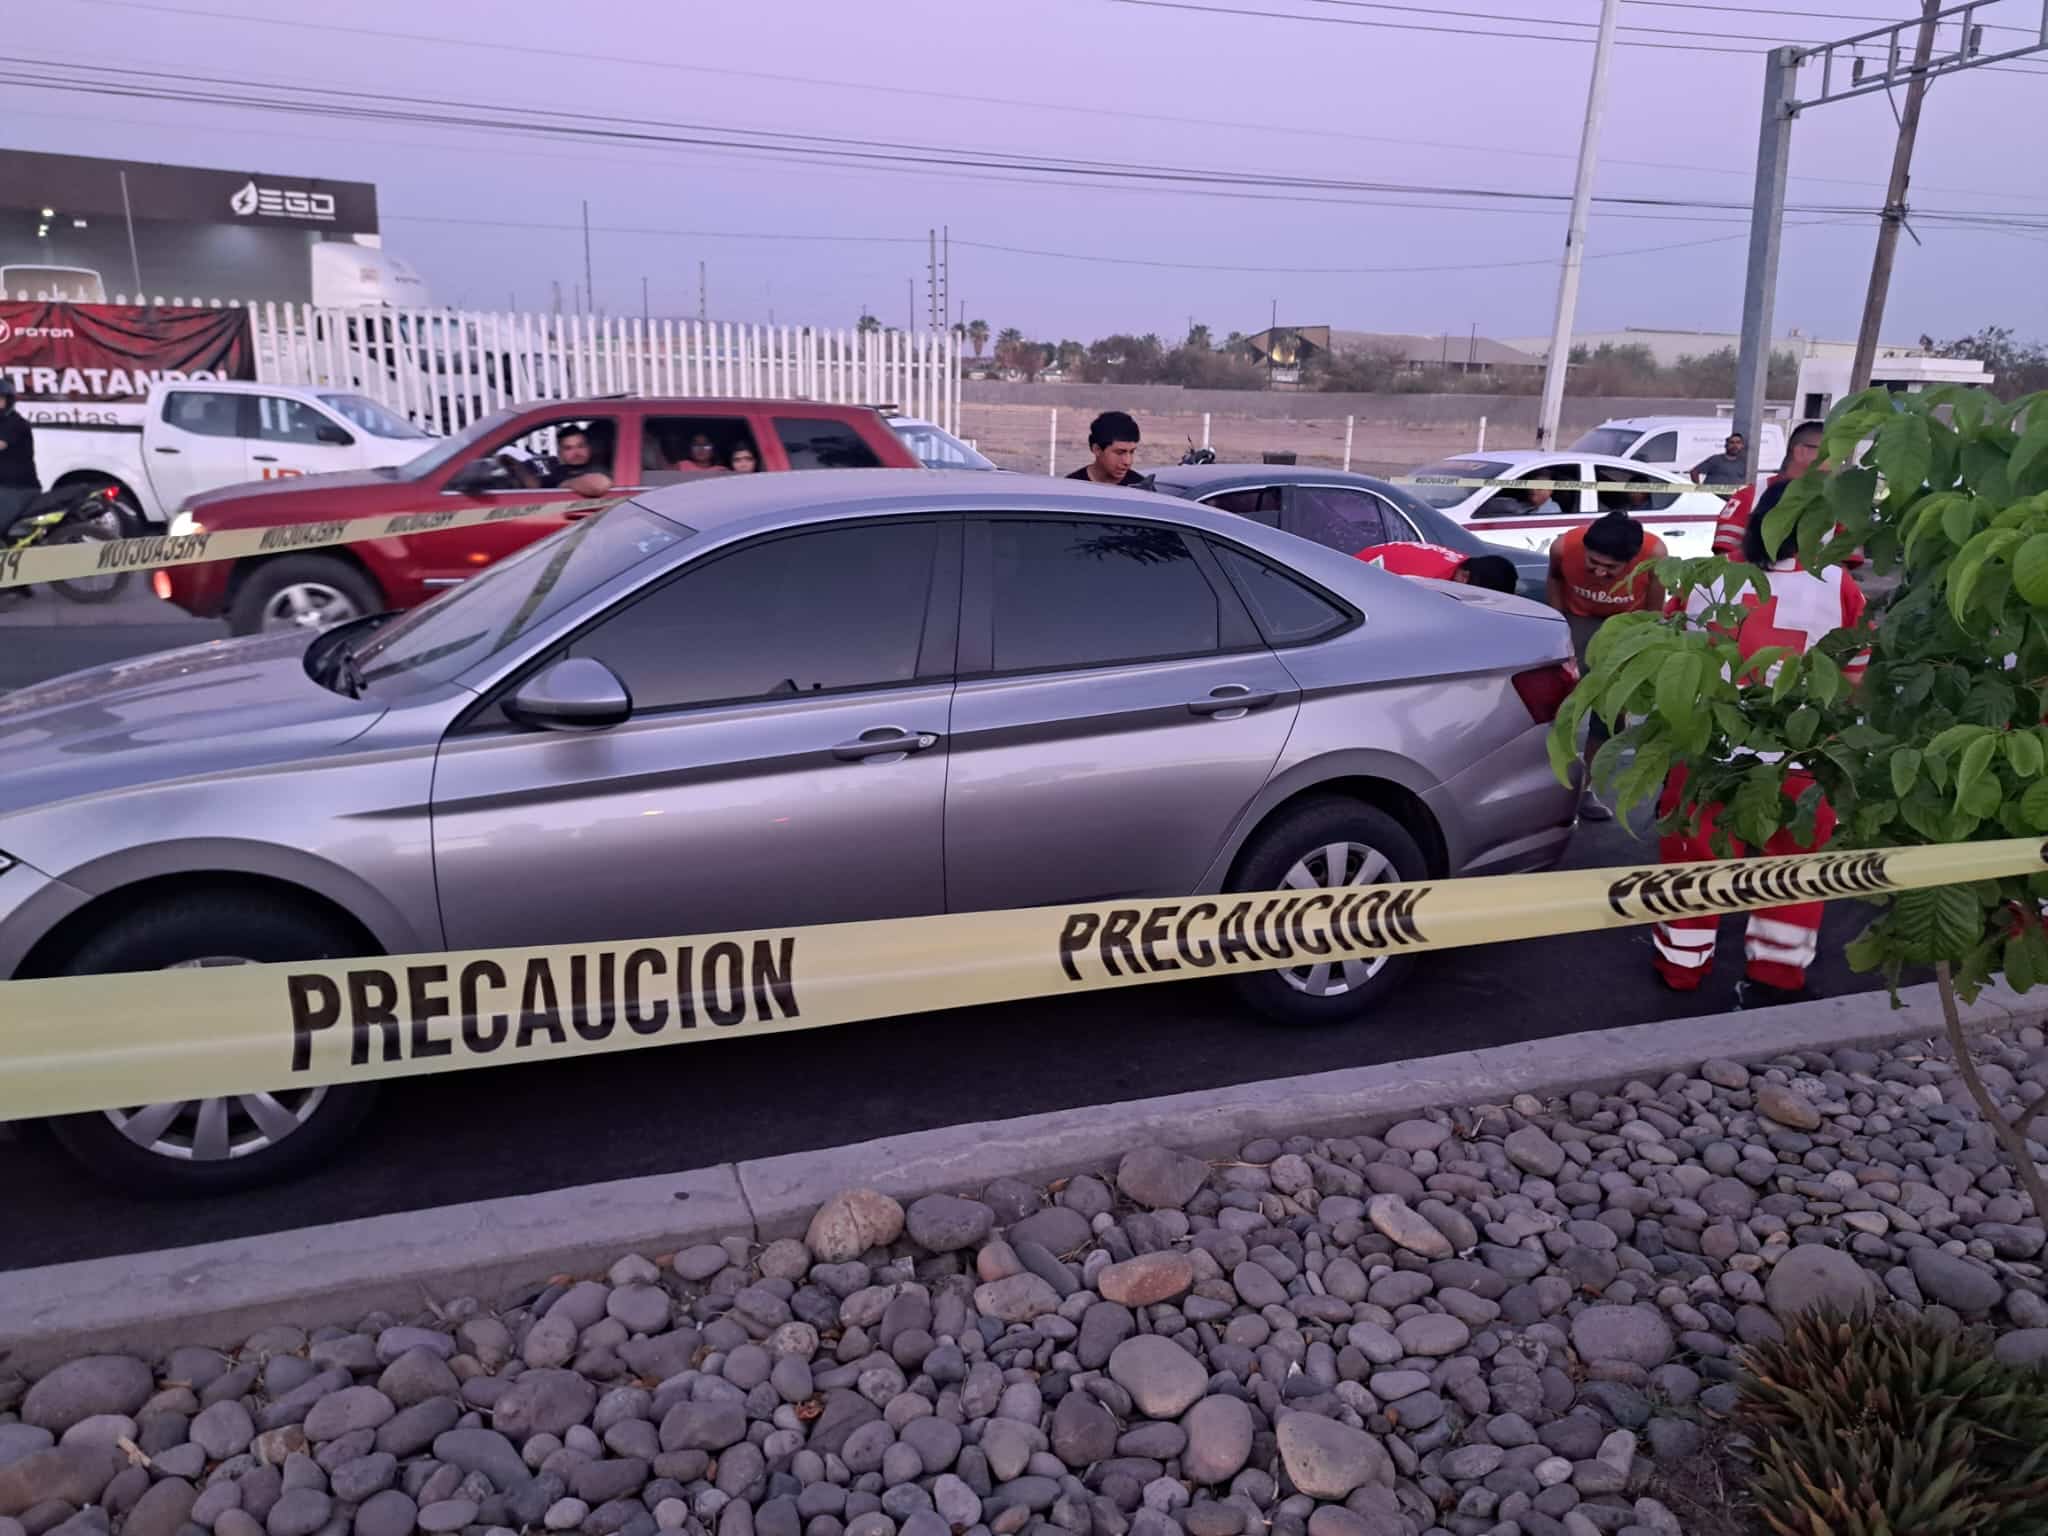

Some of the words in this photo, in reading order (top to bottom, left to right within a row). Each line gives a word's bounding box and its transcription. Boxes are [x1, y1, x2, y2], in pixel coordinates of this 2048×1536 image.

[0, 366, 227, 396] TRATAN
[287, 937, 800, 1072] PRECAUCION
[1060, 887, 1432, 981] PRECAUCION
[1608, 851, 1897, 918] PRECAUCION
